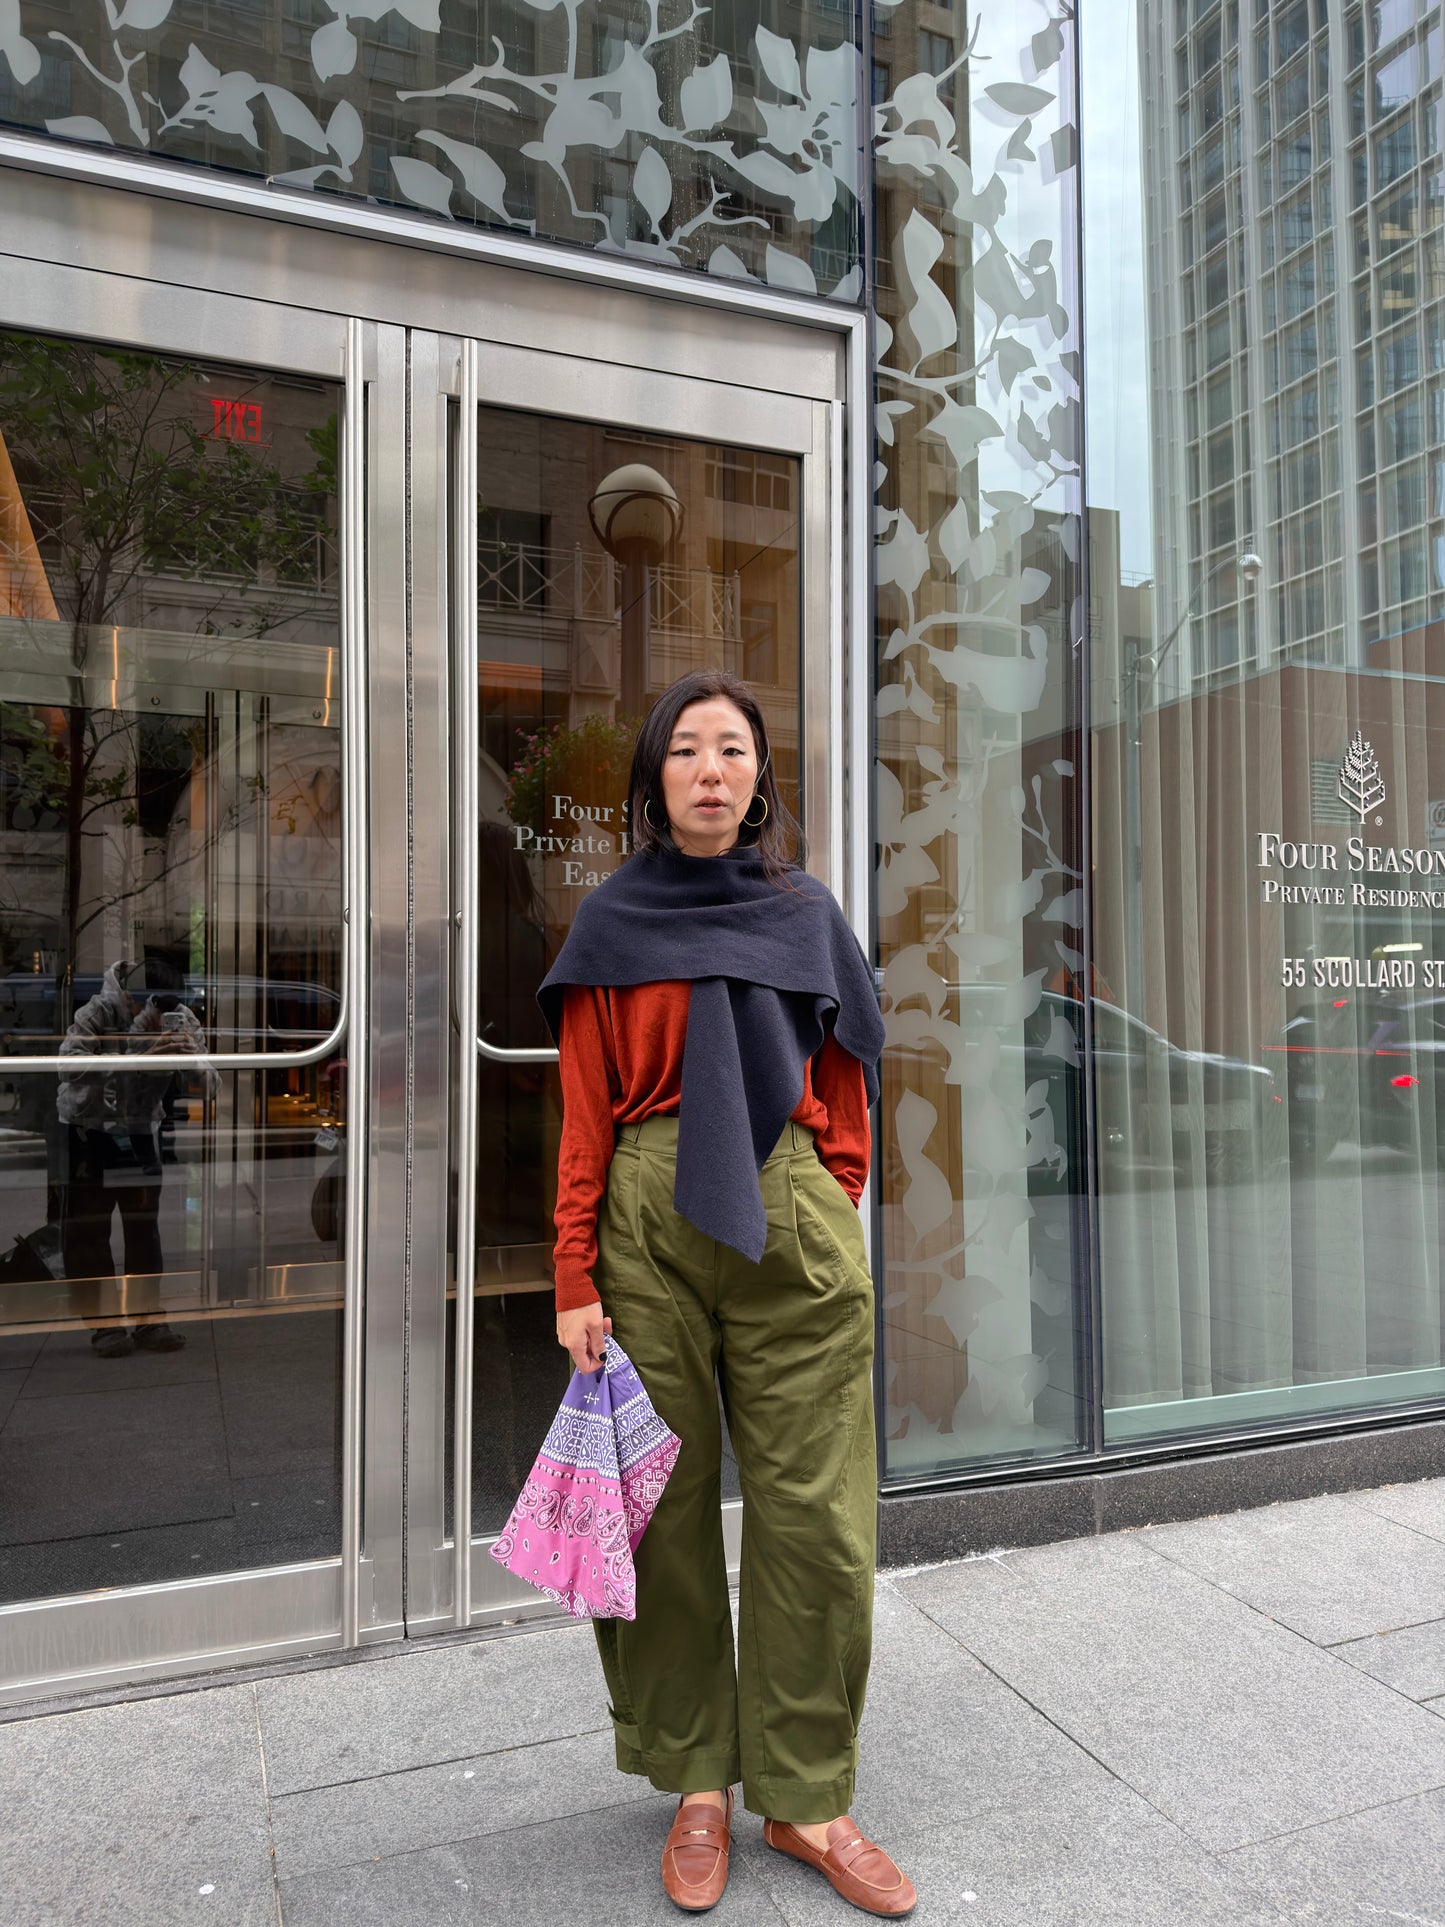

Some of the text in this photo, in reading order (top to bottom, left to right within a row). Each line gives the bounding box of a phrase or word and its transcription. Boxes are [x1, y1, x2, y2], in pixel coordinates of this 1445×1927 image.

[551, 795, 614, 822] Four
[513, 826, 611, 854] Private
[1256, 833, 1338, 871] FOUR
[562, 861, 617, 887] Eas
[1262, 880, 1445, 909] PRIVATE RESIDENC
[1281, 958, 1306, 988] 55
[1313, 958, 1416, 988] SCOLLARD
